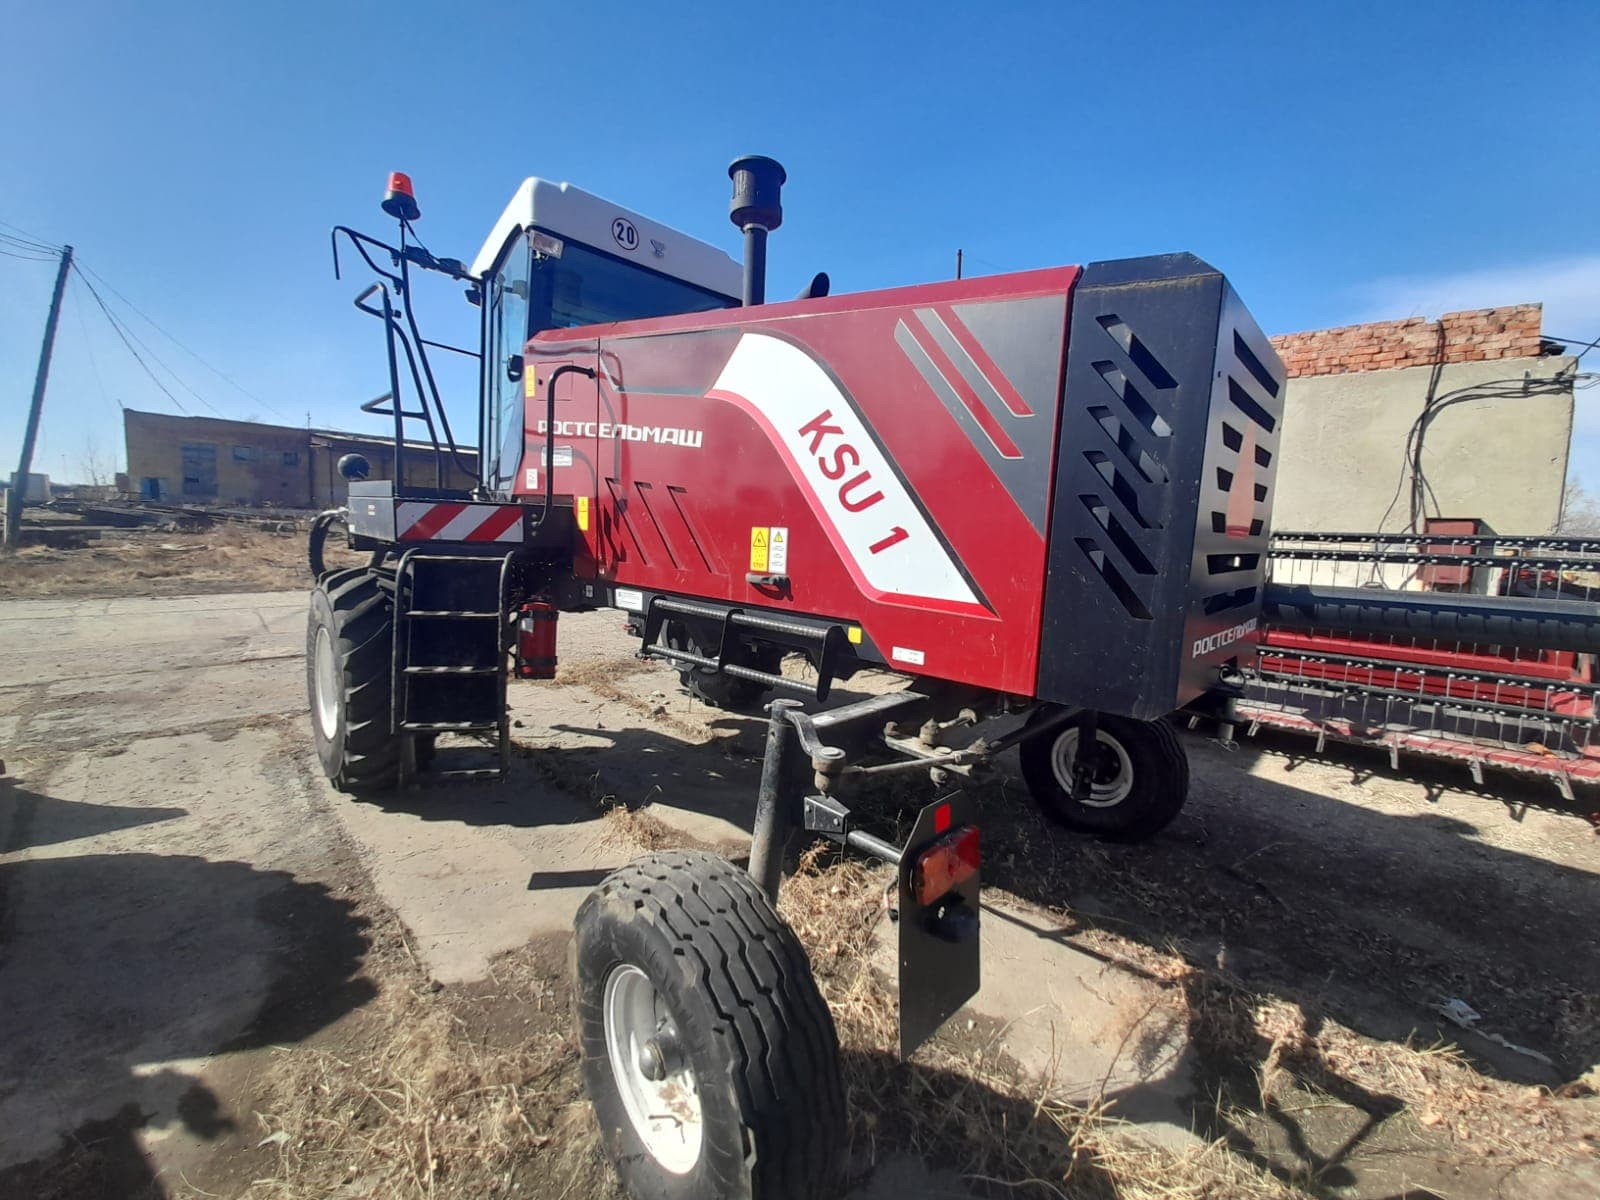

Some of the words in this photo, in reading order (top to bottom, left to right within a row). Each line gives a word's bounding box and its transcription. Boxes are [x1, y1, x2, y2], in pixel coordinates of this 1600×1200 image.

[616, 222, 635, 245] 20
[537, 420, 704, 448] РОСТСЕЛЬМАШ
[798, 409, 885, 513] KSU
[868, 526, 910, 555] 1
